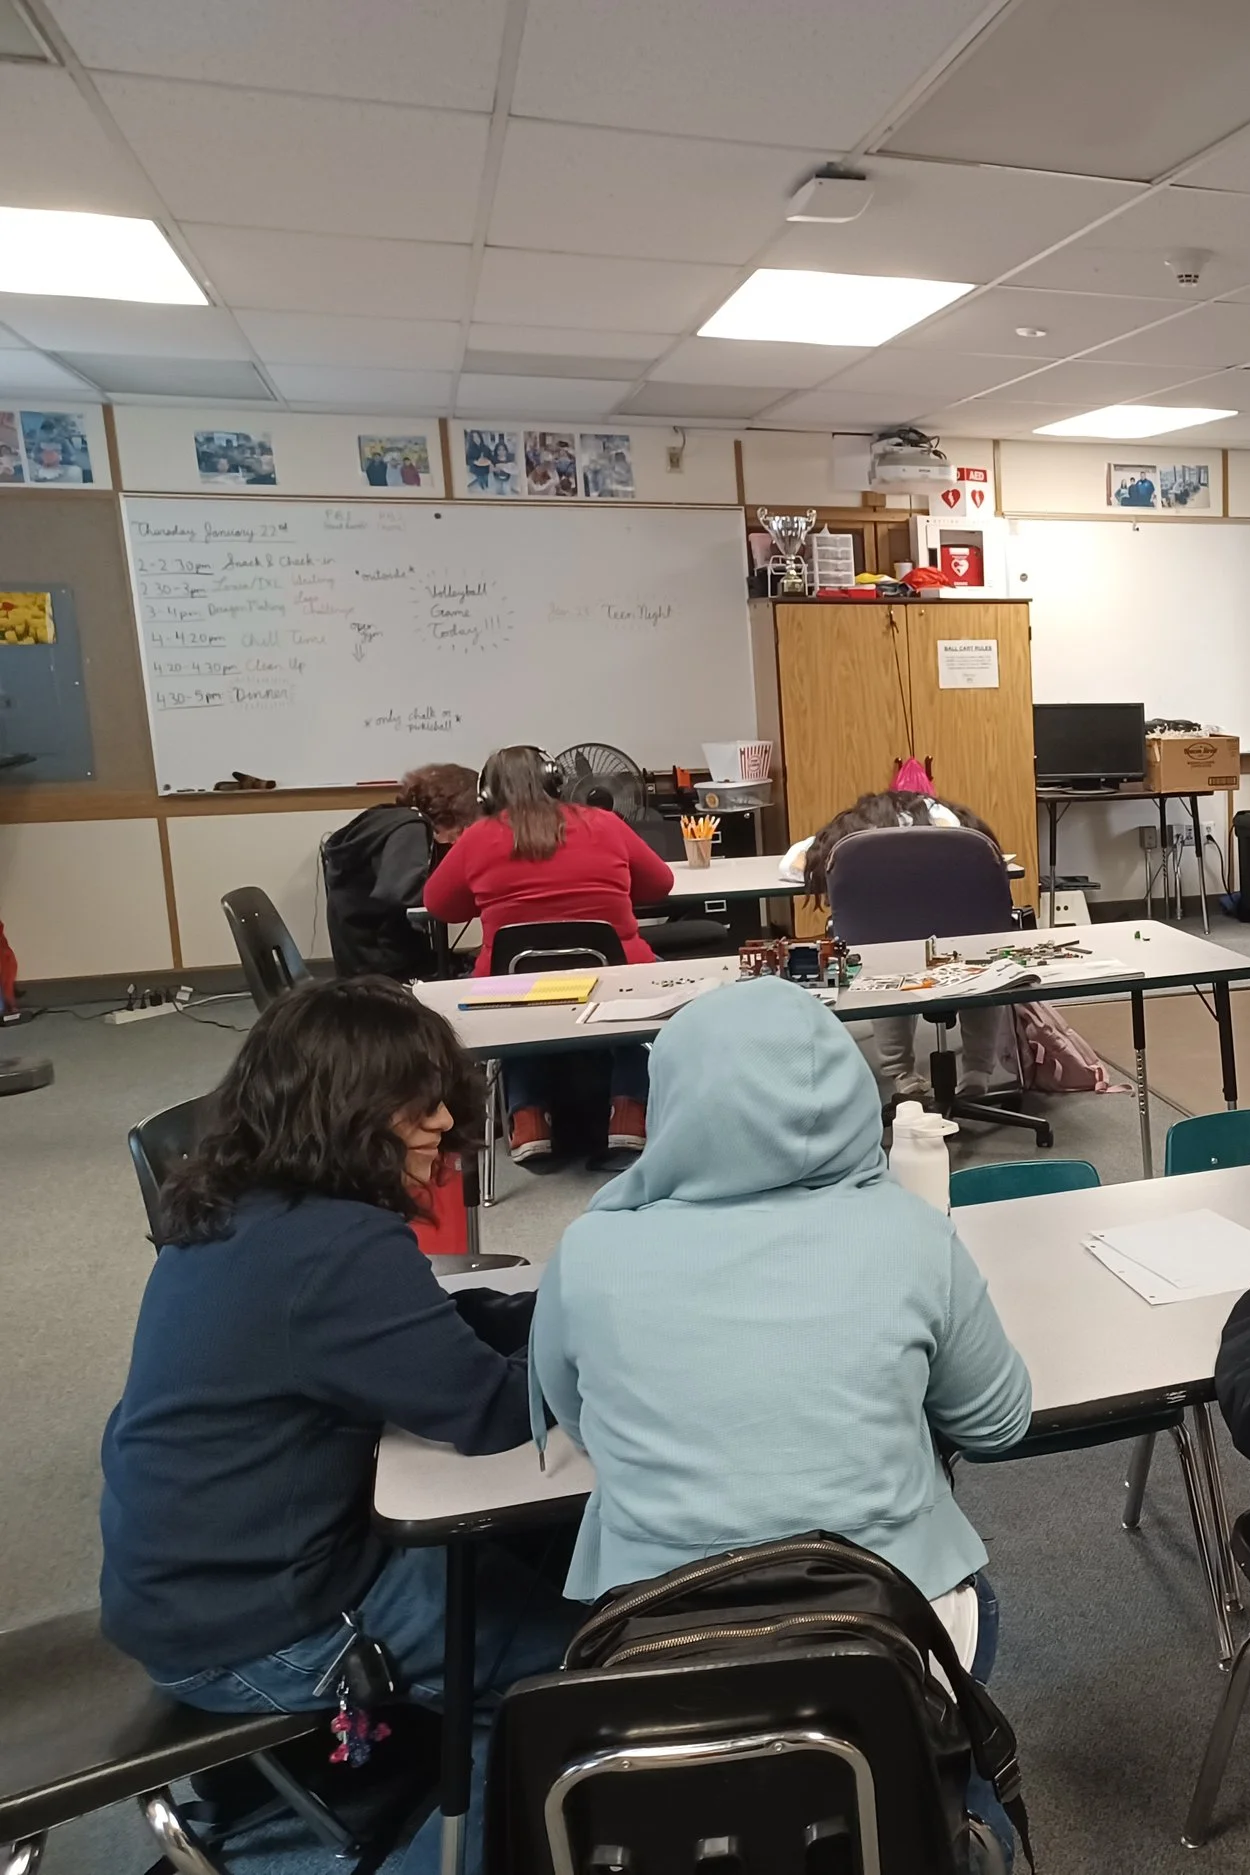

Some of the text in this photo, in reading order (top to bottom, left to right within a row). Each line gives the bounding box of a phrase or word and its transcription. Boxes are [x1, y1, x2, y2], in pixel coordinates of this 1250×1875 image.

[969, 470, 985, 481] AED
[131, 520, 196, 543] Thursday
[203, 518, 255, 544] January
[138, 557, 212, 573] 2-230pm
[221, 552, 263, 570] Snack
[425, 582, 487, 604] Volleyball
[430, 603, 471, 618] Game
[637, 602, 672, 627] Night
[151, 631, 226, 647] 4-420pm
[245, 658, 281, 673] Clean
[288, 656, 307, 673] Up
[231, 685, 289, 703] Dinner
